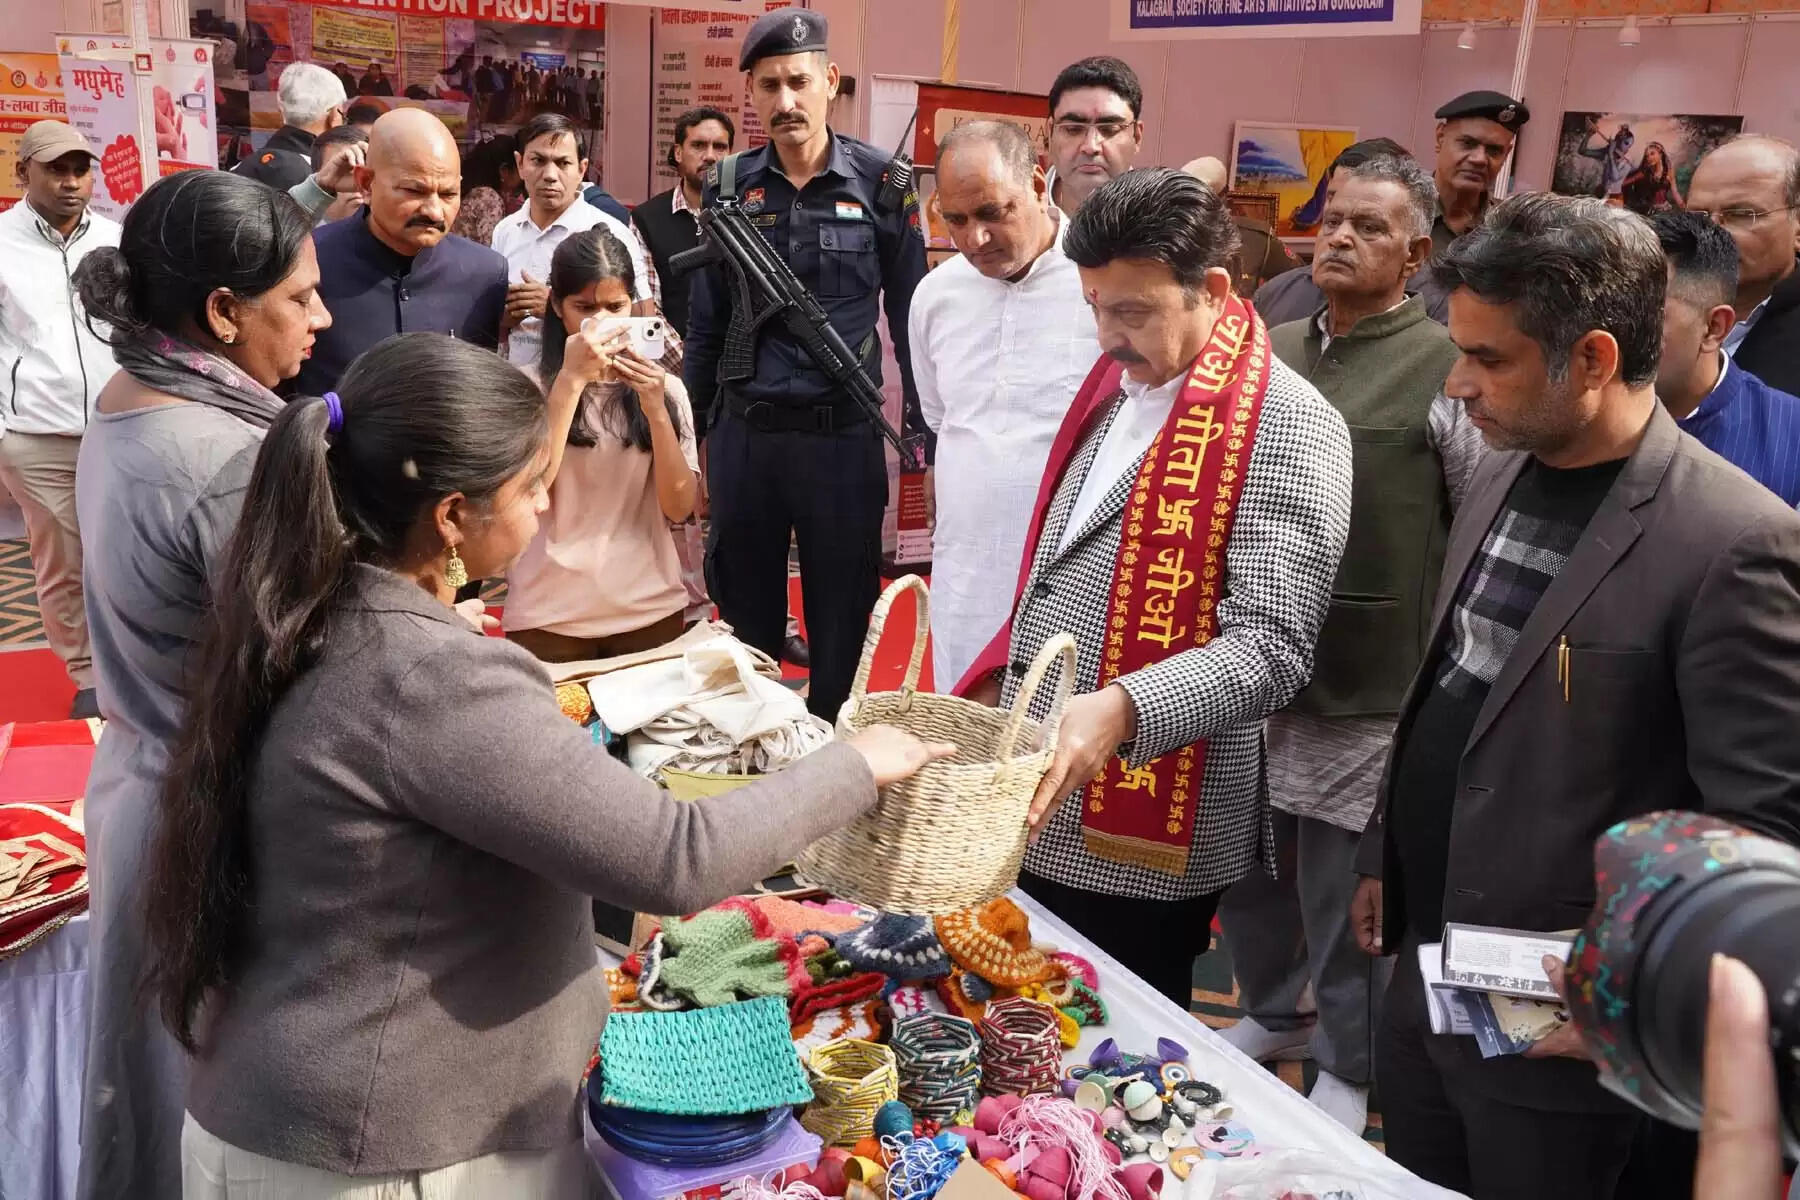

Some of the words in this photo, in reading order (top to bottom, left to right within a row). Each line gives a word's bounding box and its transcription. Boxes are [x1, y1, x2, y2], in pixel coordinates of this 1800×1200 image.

[478, 0, 601, 25] PROJECT
[1176, 0, 1206, 17] SOCIETY
[1208, 0, 1224, 15] FOR
[1225, 0, 1242, 14] FINE
[1244, 0, 1265, 13] ARTS
[1267, 0, 1316, 12] INITIATIVES
[1318, 0, 1329, 11] IN
[72, 65, 125, 100] मधुमेह
[1163, 405, 1225, 493] गीता
[1137, 548, 1195, 649] जीओ
